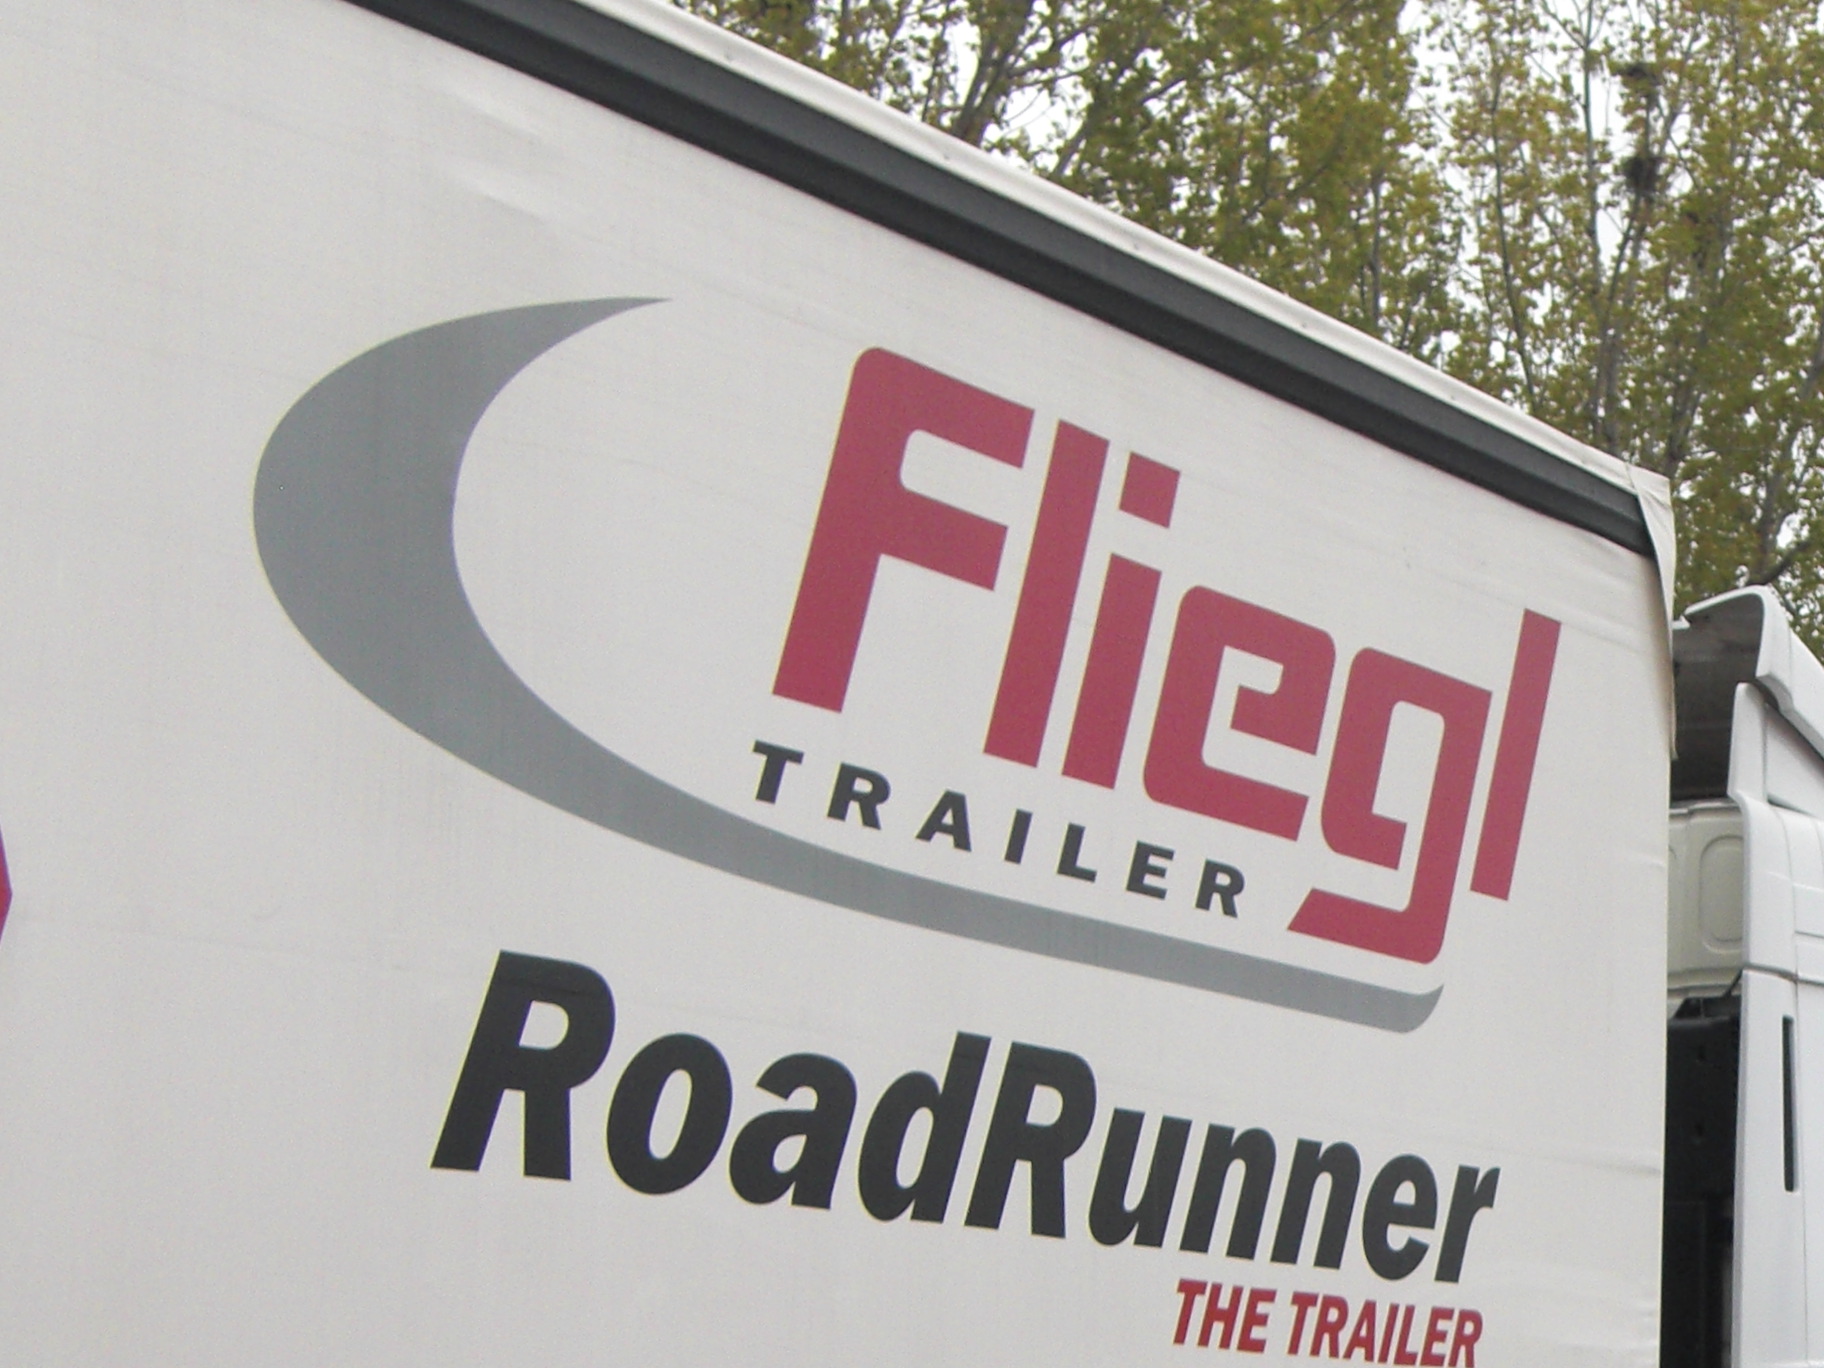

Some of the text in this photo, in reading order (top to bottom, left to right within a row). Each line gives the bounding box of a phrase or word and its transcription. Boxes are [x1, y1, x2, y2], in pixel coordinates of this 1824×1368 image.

[772, 347, 1562, 966] Fliegl
[752, 740, 1245, 918] TRAILER
[429, 949, 1501, 1284] RoadRunner
[1173, 1278, 1277, 1354] THE
